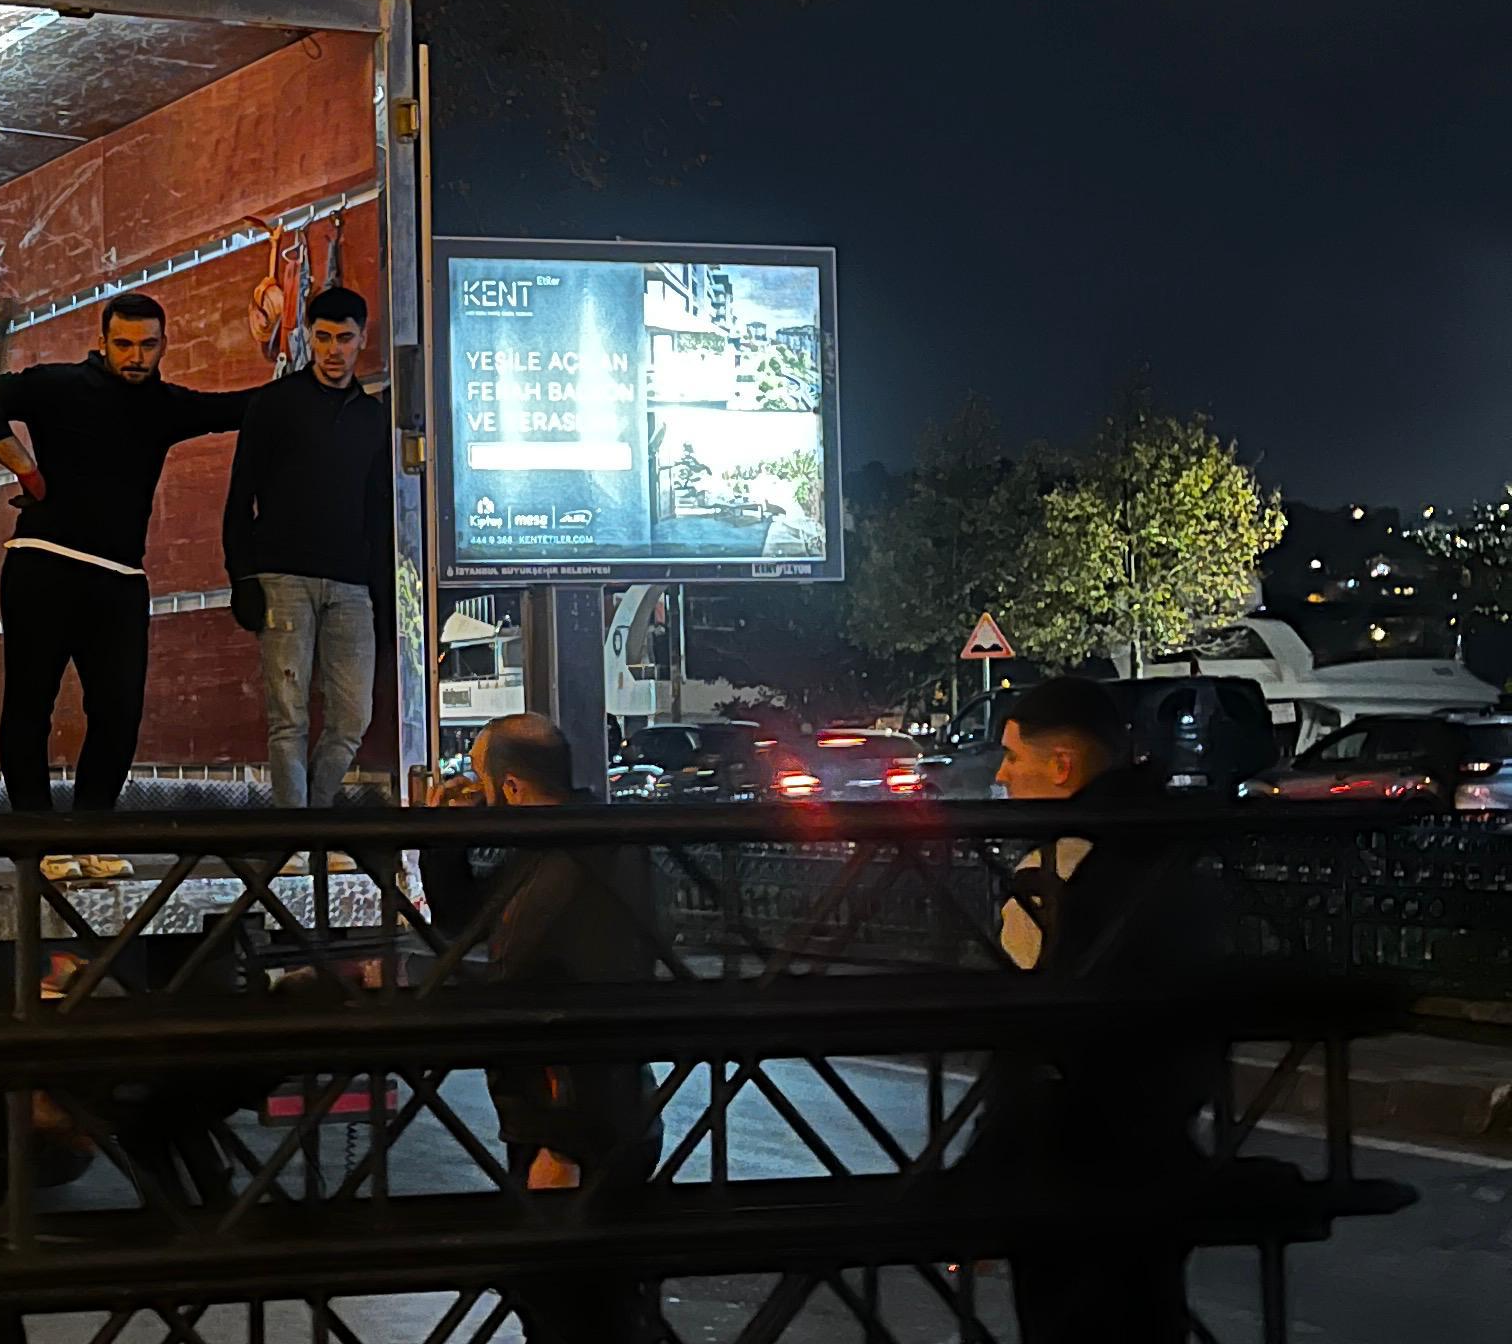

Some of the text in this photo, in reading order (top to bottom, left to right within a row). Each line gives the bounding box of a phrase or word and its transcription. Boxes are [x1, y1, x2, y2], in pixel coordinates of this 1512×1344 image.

[464, 280, 533, 307] KENT
[466, 348, 542, 376] YEŞİLE
[467, 412, 497, 432] VE
